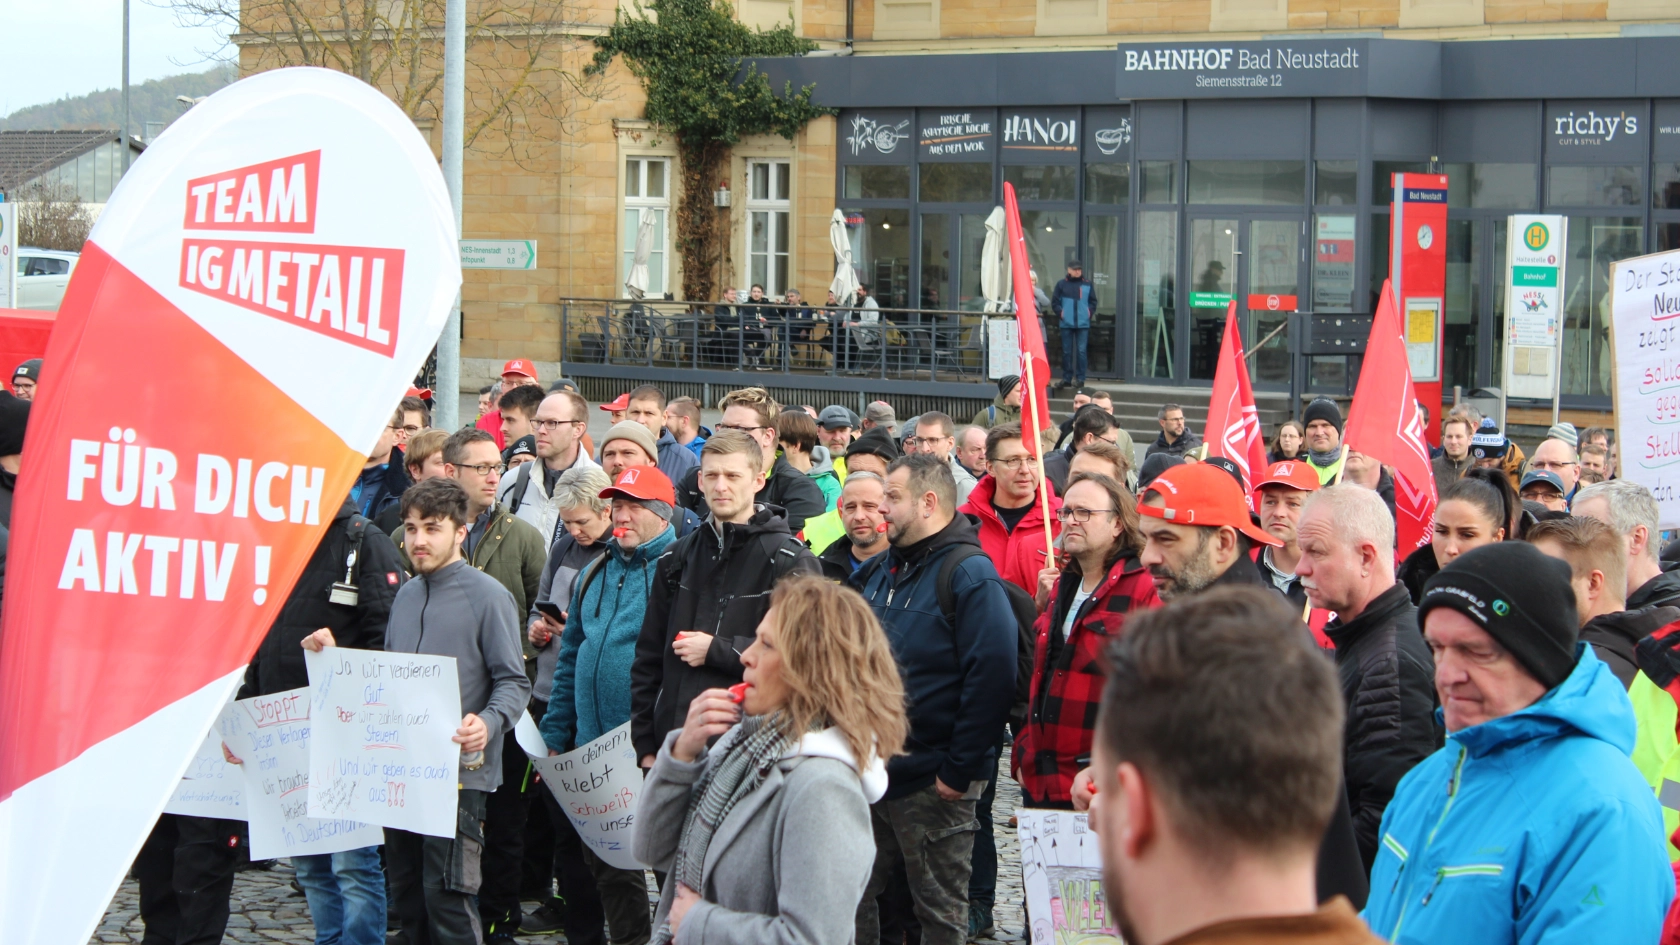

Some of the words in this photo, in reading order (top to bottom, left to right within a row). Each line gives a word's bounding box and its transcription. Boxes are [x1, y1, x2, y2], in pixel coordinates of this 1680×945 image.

[1124, 48, 1233, 71] BAHNHOF
[1237, 48, 1271, 70] Bad
[1276, 47, 1360, 69] Neustadt
[1195, 74, 1268, 87] Siemensstraße
[1270, 75, 1282, 87] 12
[1004, 115, 1076, 145] HANOI
[1555, 111, 1638, 141] richy's
[1659, 126, 1672, 134] WIR
[928, 144, 944, 155] AUS
[963, 141, 985, 152] WOK
[1559, 138, 1573, 146] CUT
[1580, 138, 1601, 146] STYLE
[191, 162, 307, 223] TEAM
[1409, 191, 1420, 200] Bad
[1420, 191, 1442, 200] Neustadt
[461, 246, 502, 254] NES-Innenstadt
[1625, 269, 1652, 292] Der
[186, 245, 224, 290] IG
[227, 248, 390, 346] METALL
[1639, 320, 1676, 351] zeigt
[1645, 431, 1680, 459] Stell
[67, 426, 178, 511] FÜR
[194, 453, 326, 526] DICH
[1652, 477, 1673, 502] den
[57, 528, 239, 602] AKTIV
[252, 546, 272, 606] !
[335, 653, 352, 676] Ja
[390, 660, 441, 680] verdienen
[363, 682, 385, 704] Gut
[253, 692, 301, 723] Stoppt
[406, 708, 430, 727] auch
[554, 759, 574, 771] an
[581, 730, 628, 765] deinem
[277, 769, 309, 793] brauche
[382, 760, 406, 783] geben
[410, 765, 421, 777] es
[424, 761, 450, 780] auch
[561, 763, 614, 793] klebt
[570, 786, 633, 816] Schweiß
[600, 814, 635, 832] unse
